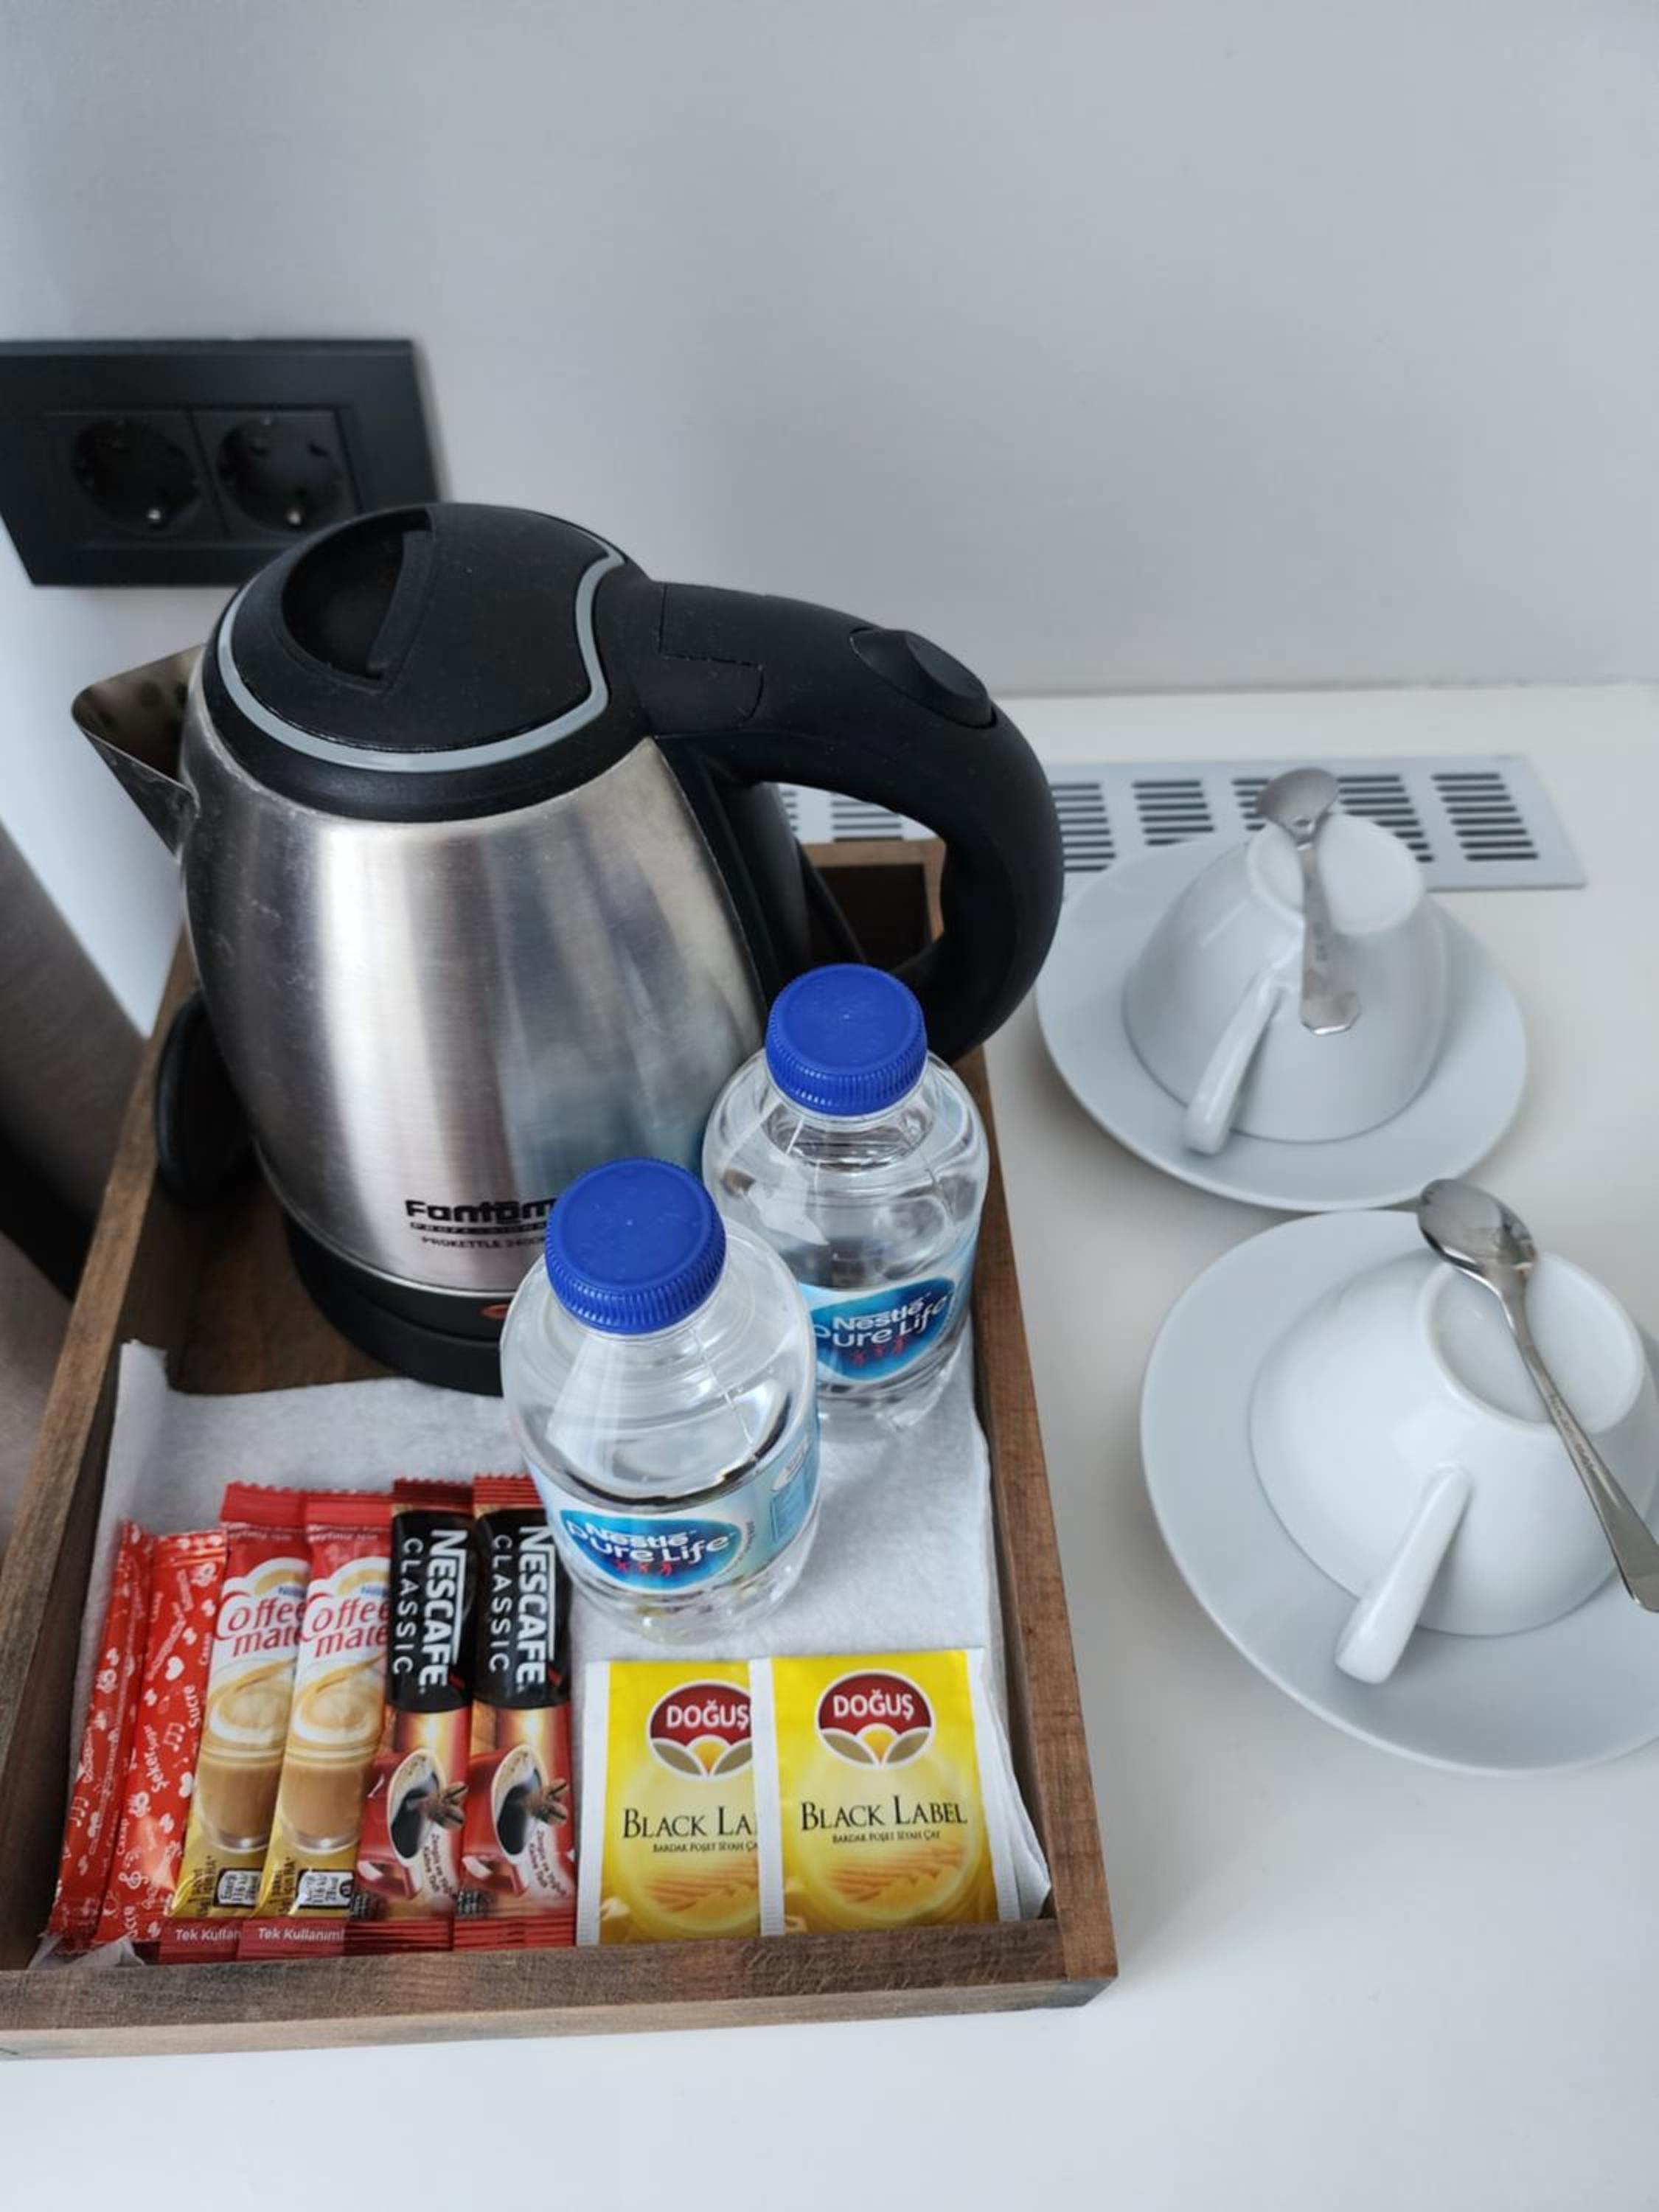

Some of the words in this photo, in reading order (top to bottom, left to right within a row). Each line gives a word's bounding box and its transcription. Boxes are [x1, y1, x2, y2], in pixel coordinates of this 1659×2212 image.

[899, 1296, 947, 1335] Life
[662, 1535, 730, 1564] Life
[392, 1537, 425, 1675] CLASSIC
[488, 1534, 514, 1673] CLASSIC
[182, 1684, 201, 1728] Sucre
[667, 1699, 751, 1731] DOĞUŞ
[832, 1688, 915, 1721] DOĞUŞ
[623, 1807, 708, 1839] BLACK
[717, 1805, 757, 1837] LA
[801, 1801, 886, 1832] BLACK
[893, 1795, 968, 1825] LABEL
[175, 1928, 198, 1941] Tek
[257, 1927, 282, 1940] Tek
